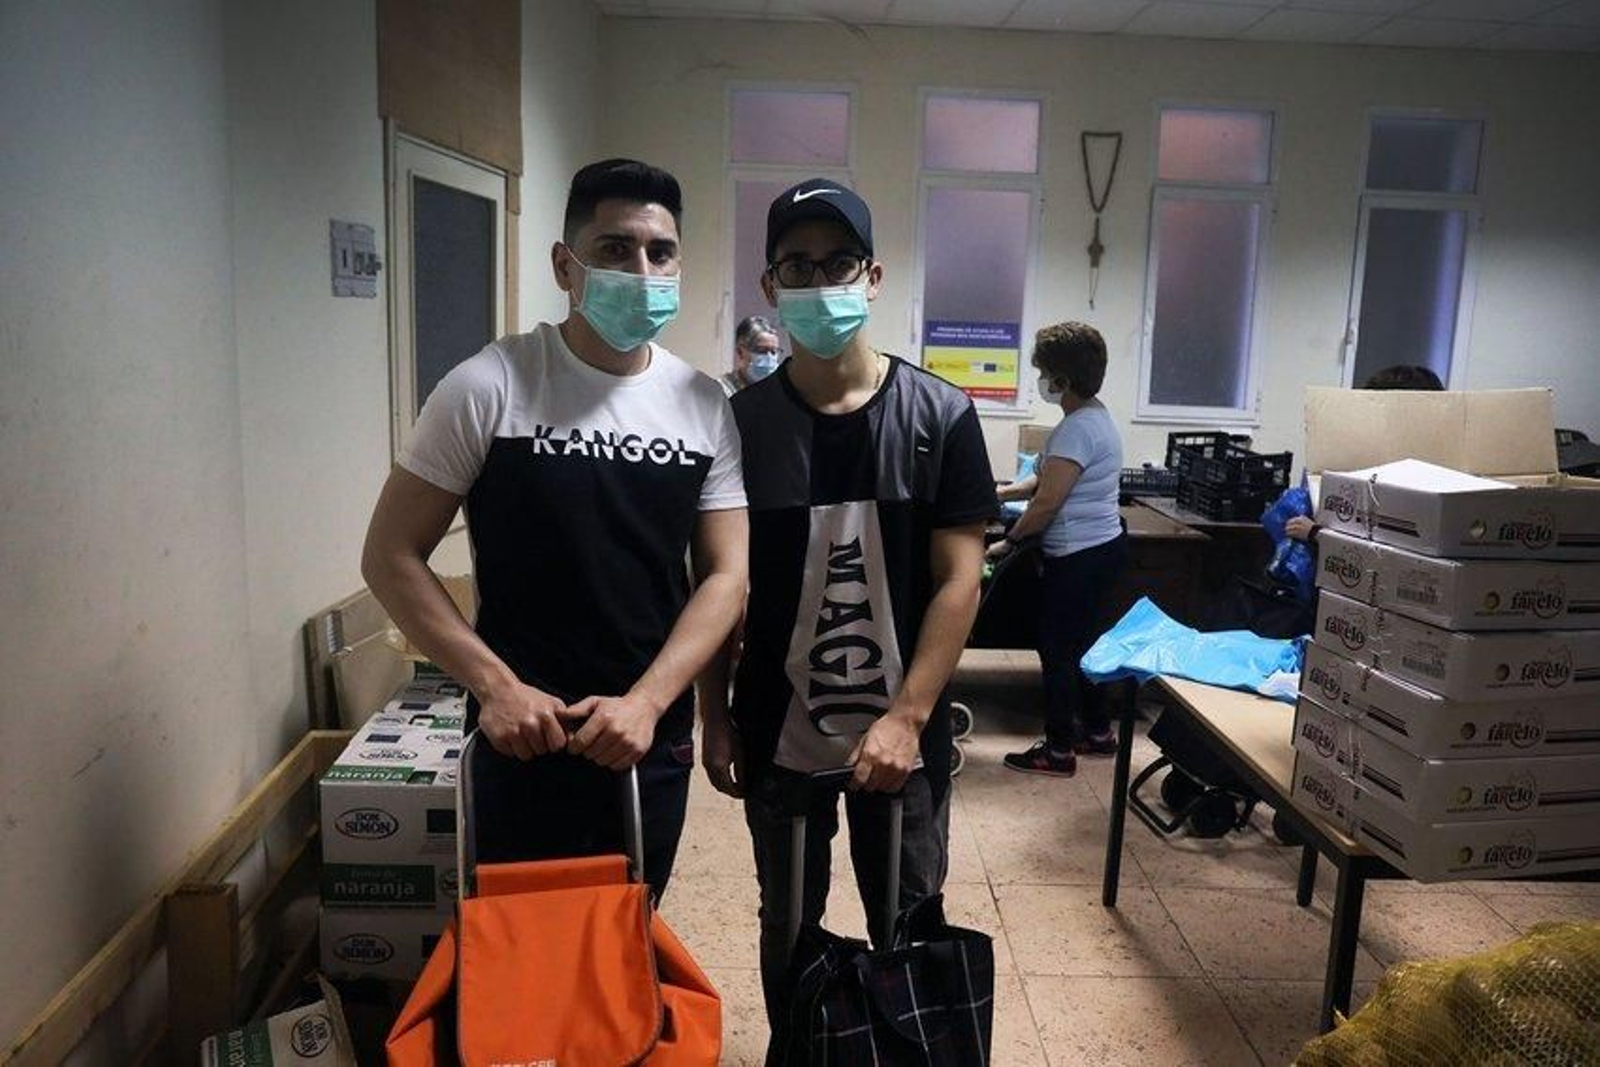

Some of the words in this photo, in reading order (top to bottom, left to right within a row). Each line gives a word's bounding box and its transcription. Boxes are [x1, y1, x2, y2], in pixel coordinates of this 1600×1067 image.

[533, 424, 696, 465] KANGOL
[808, 535, 890, 737] MAGIC
[328, 770, 404, 780] naranja
[355, 812, 380, 821] DON
[333, 878, 416, 898] naranja
